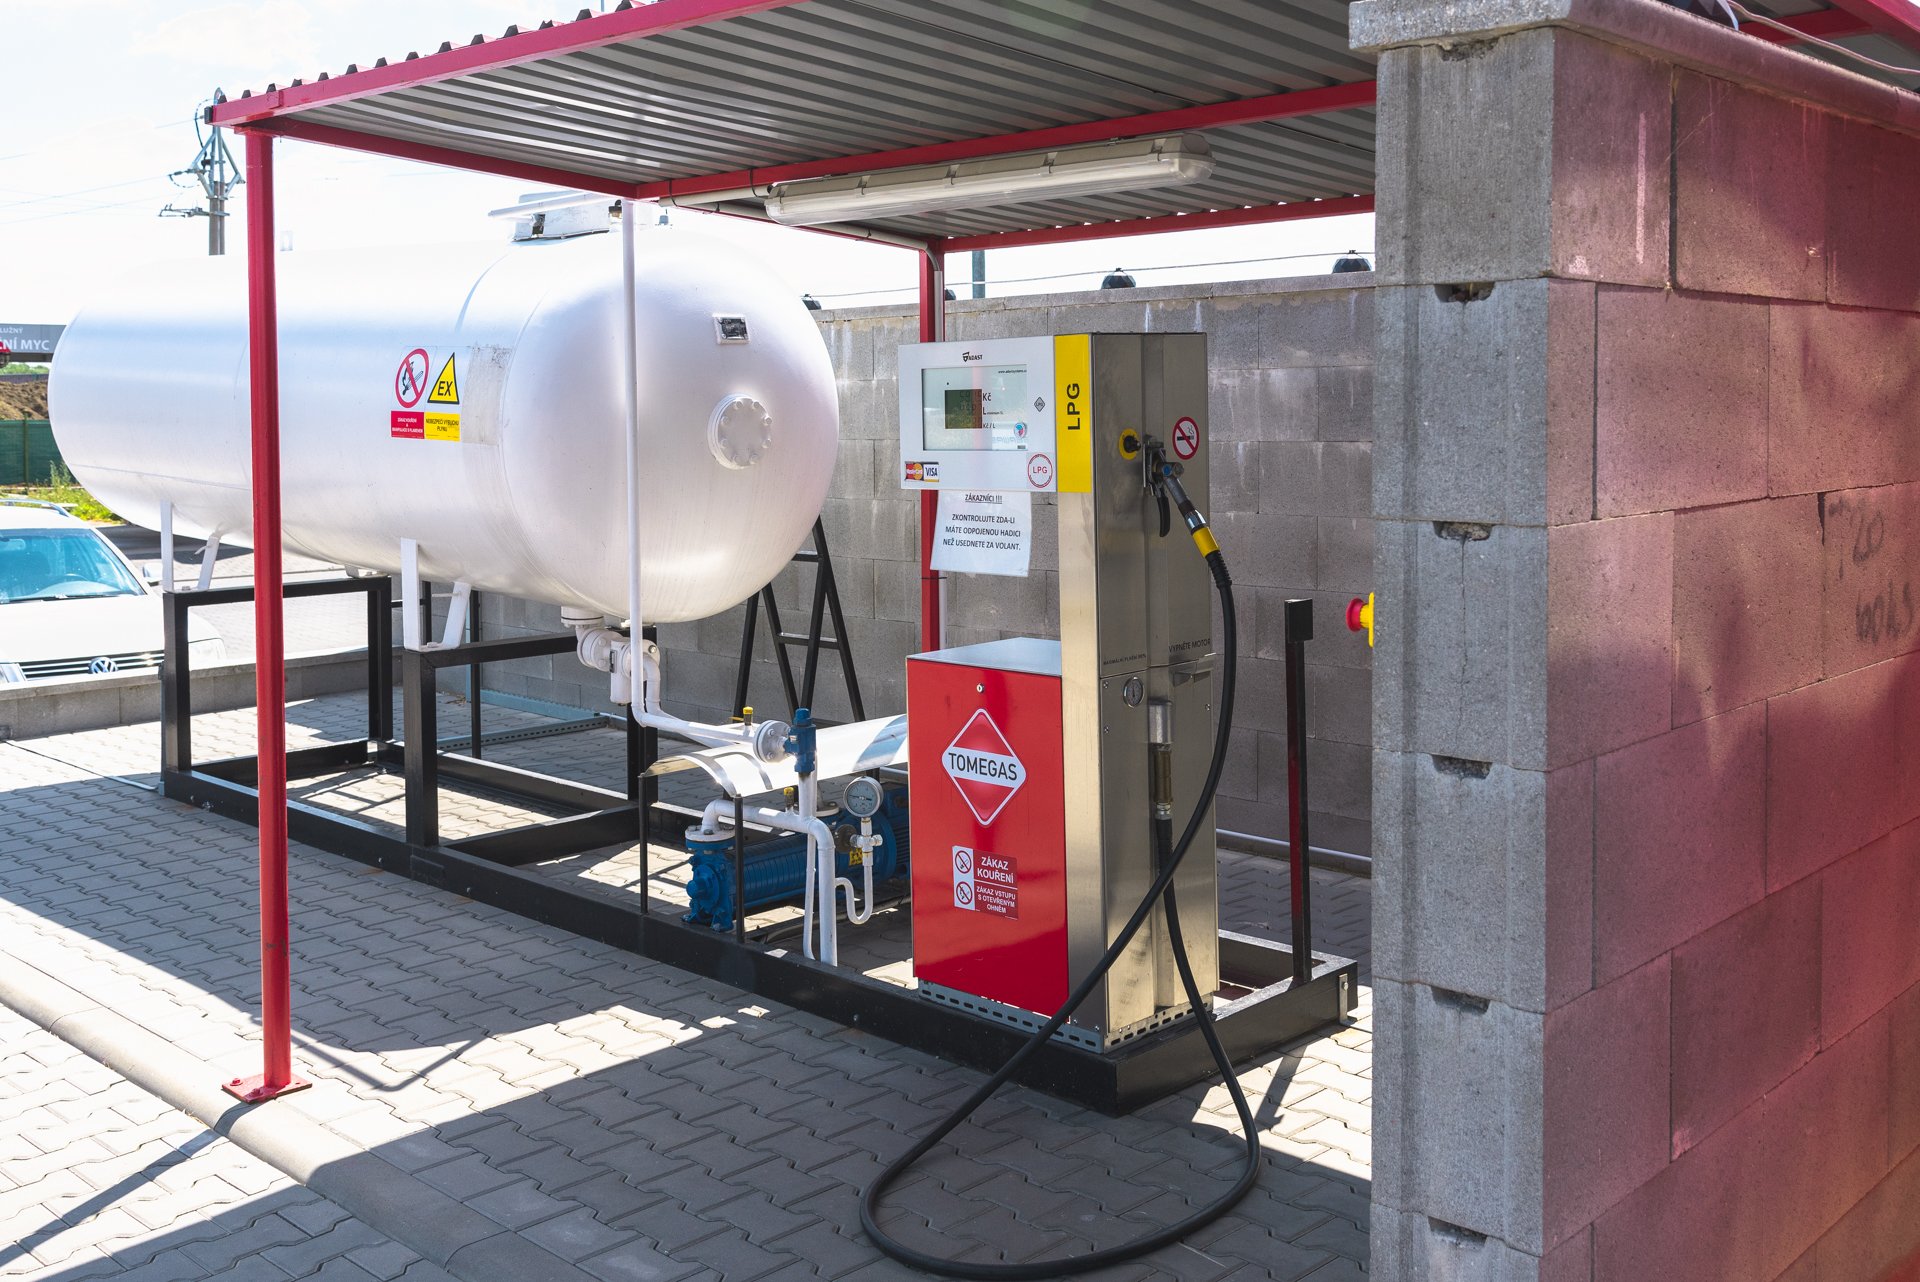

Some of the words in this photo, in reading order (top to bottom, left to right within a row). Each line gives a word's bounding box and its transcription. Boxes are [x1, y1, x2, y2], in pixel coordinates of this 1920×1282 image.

[20, 339, 50, 351] MYC
[438, 381, 453, 396] EX
[982, 392, 992, 401] Kč
[982, 407, 987, 415] L
[1066, 383, 1080, 430] LPG
[925, 467, 938, 477] VISA
[1032, 466, 1048, 474] LPG
[964, 492, 995, 502] ZÁKAZNÍCI
[951, 514, 995, 523] ZKONTROLUJTE
[996, 515, 1015, 524] ZDA-LI
[945, 525, 962, 534] MÁTE
[963, 527, 999, 536] ODPOJENOU
[1000, 529, 1021, 538] HADICI
[943, 537, 954, 546] NEŽ
[955, 539, 986, 549] USEDNETE
[986, 541, 994, 549] ZA
[995, 542, 1021, 551] VOLANT.
[1169, 641, 1191, 653] VYPNĚTE
[1191, 638, 1211, 648] MOTOR
[949, 753, 1017, 781] TOMEGAS
[981, 855, 1009, 871] ZÁKAZ
[977, 867, 1014, 884] KOUŘENÍ
[976, 885, 994, 896] ZÁKAZ
[994, 889, 1016, 900] VSTUPU
[982, 893, 1016, 908] OTEVŘENÝM
[986, 903, 1007, 914] OHNĚM
